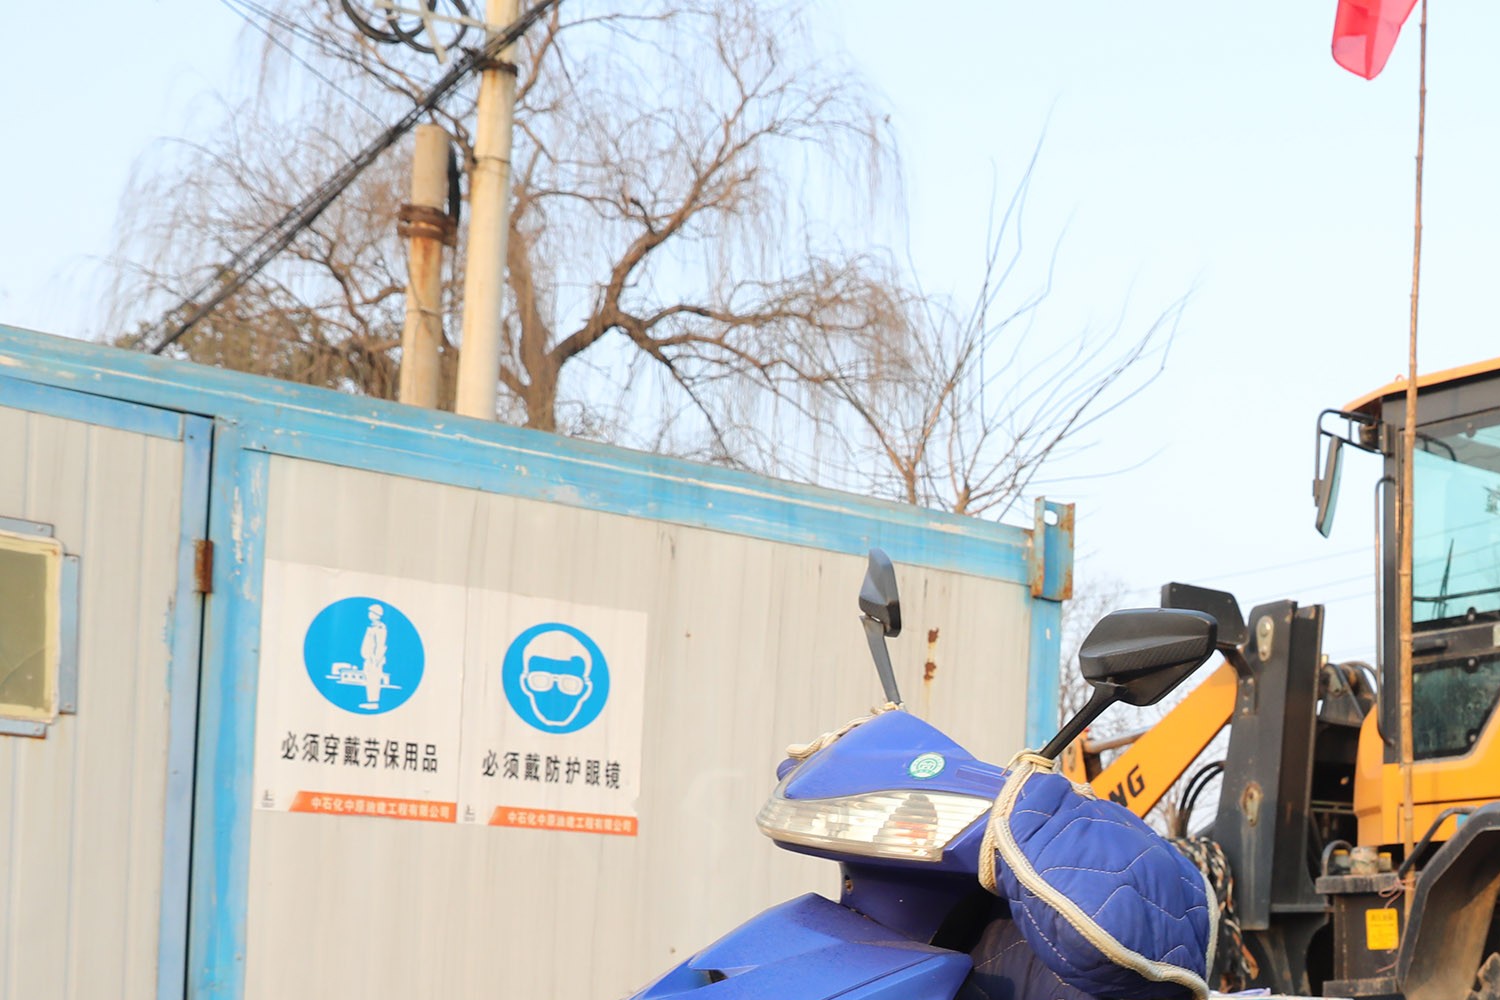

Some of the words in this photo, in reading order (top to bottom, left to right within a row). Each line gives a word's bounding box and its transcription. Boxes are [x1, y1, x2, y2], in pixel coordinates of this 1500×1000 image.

[281, 731, 438, 773] 必须穿戴劳保用品
[482, 749, 622, 790] 必须戴防护眼镜
